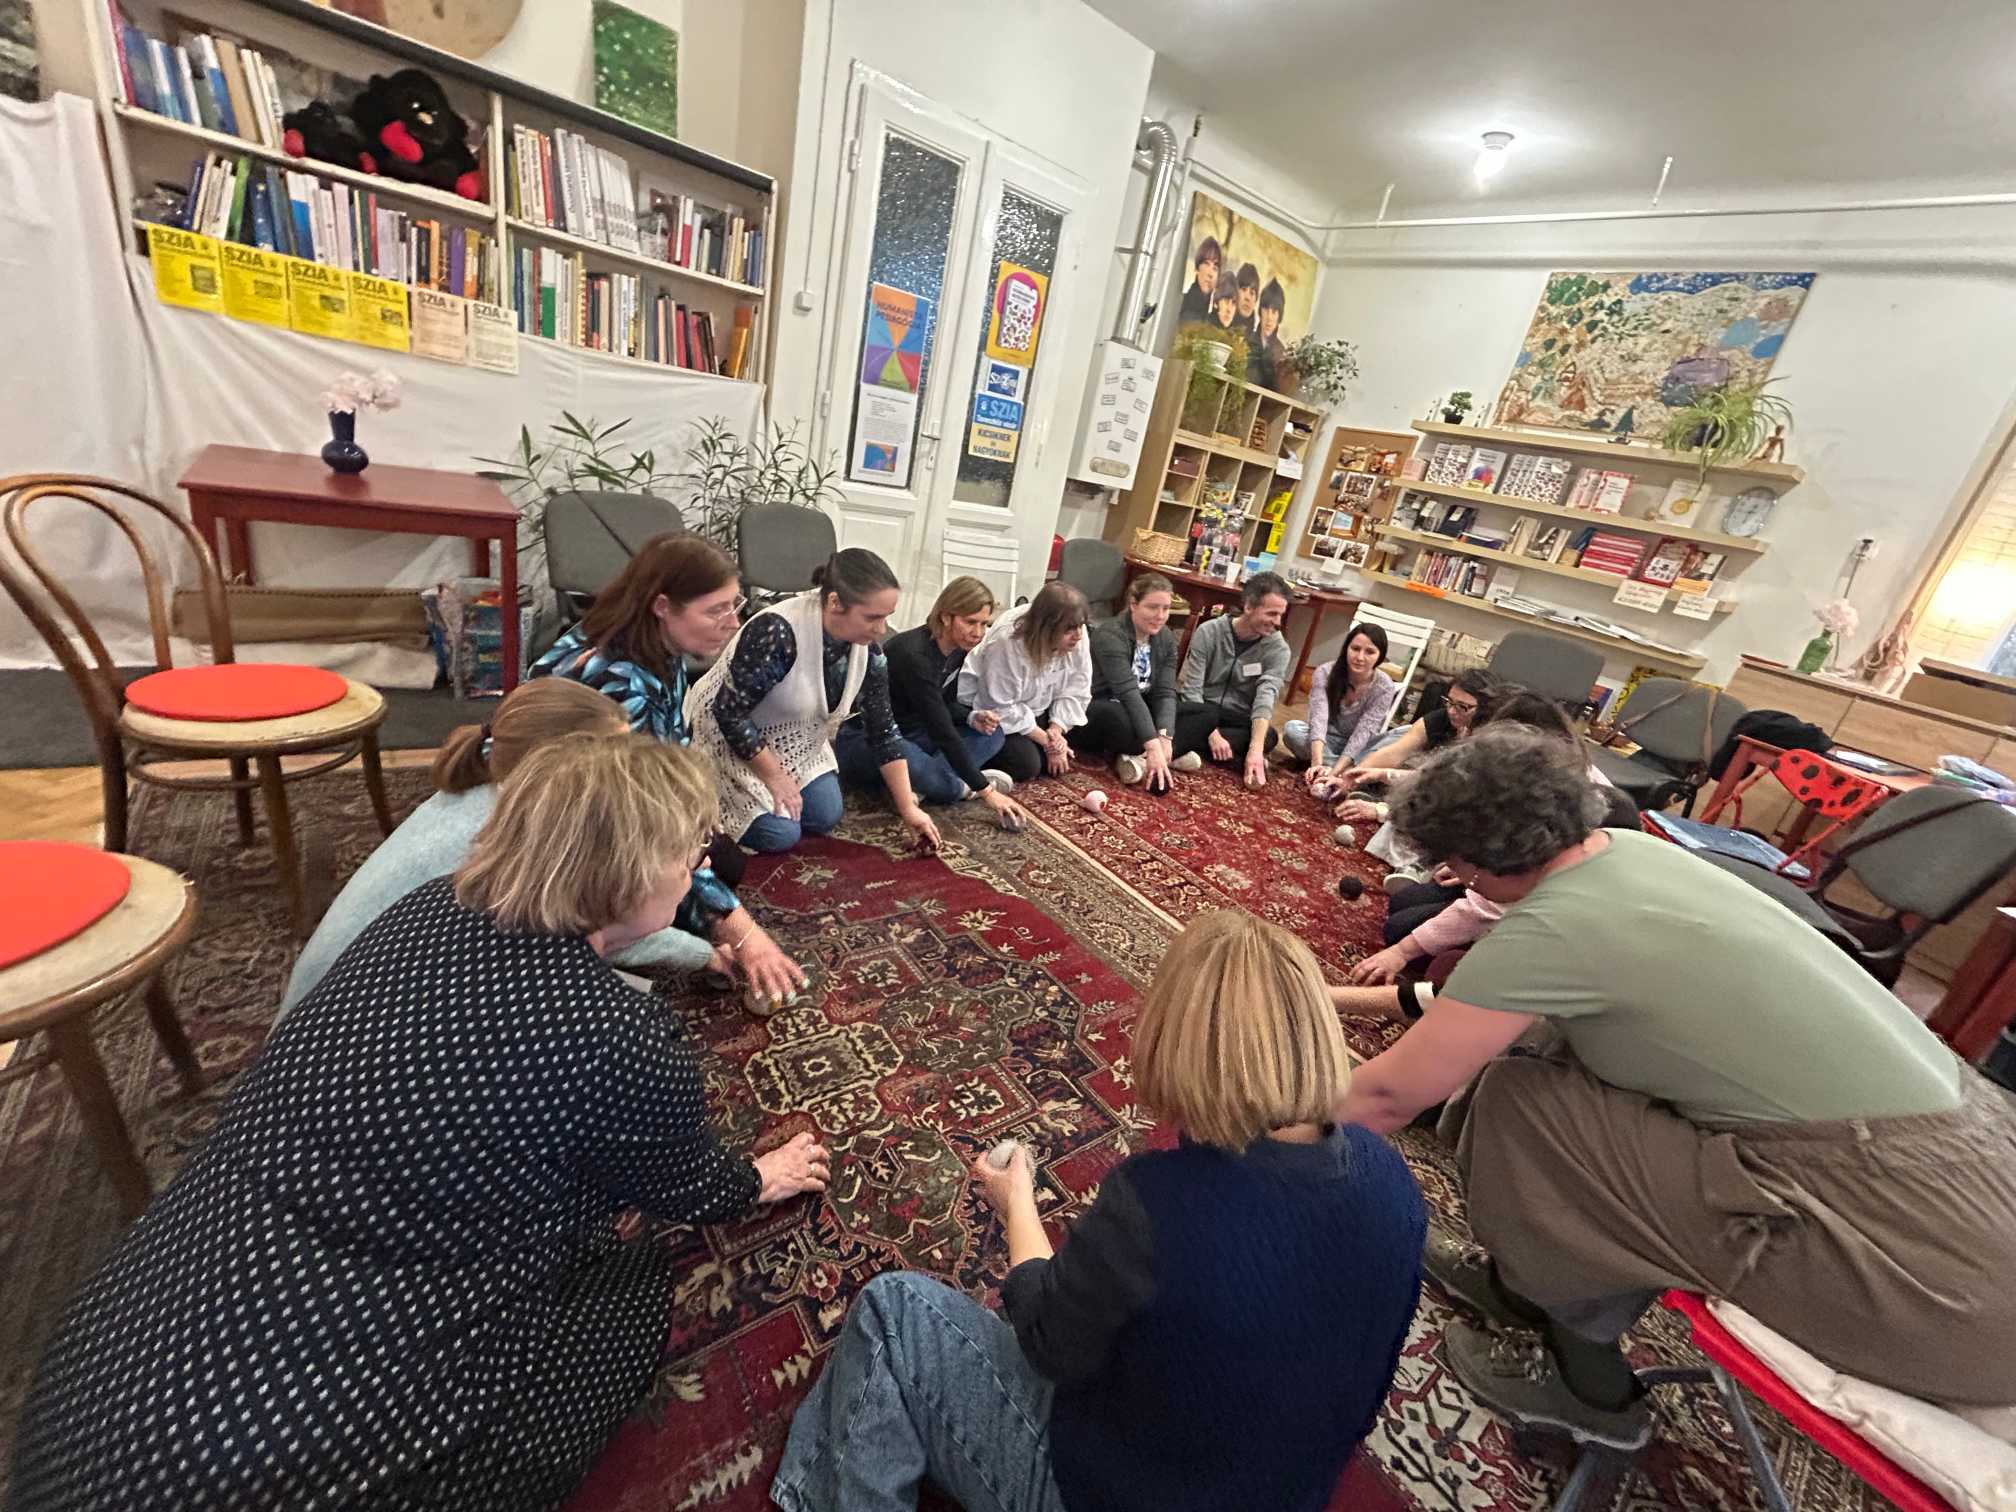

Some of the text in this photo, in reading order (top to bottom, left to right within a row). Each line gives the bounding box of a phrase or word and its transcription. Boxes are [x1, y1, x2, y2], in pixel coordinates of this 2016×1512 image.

[151, 228, 196, 250] SZIA
[223, 246, 265, 267] SZIA
[290, 261, 329, 281] SZIA
[352, 276, 389, 296] SZIA
[417, 291, 447, 308] SZIA
[473, 303, 501, 318] SZIA
[989, 400, 1019, 421] SZIA
